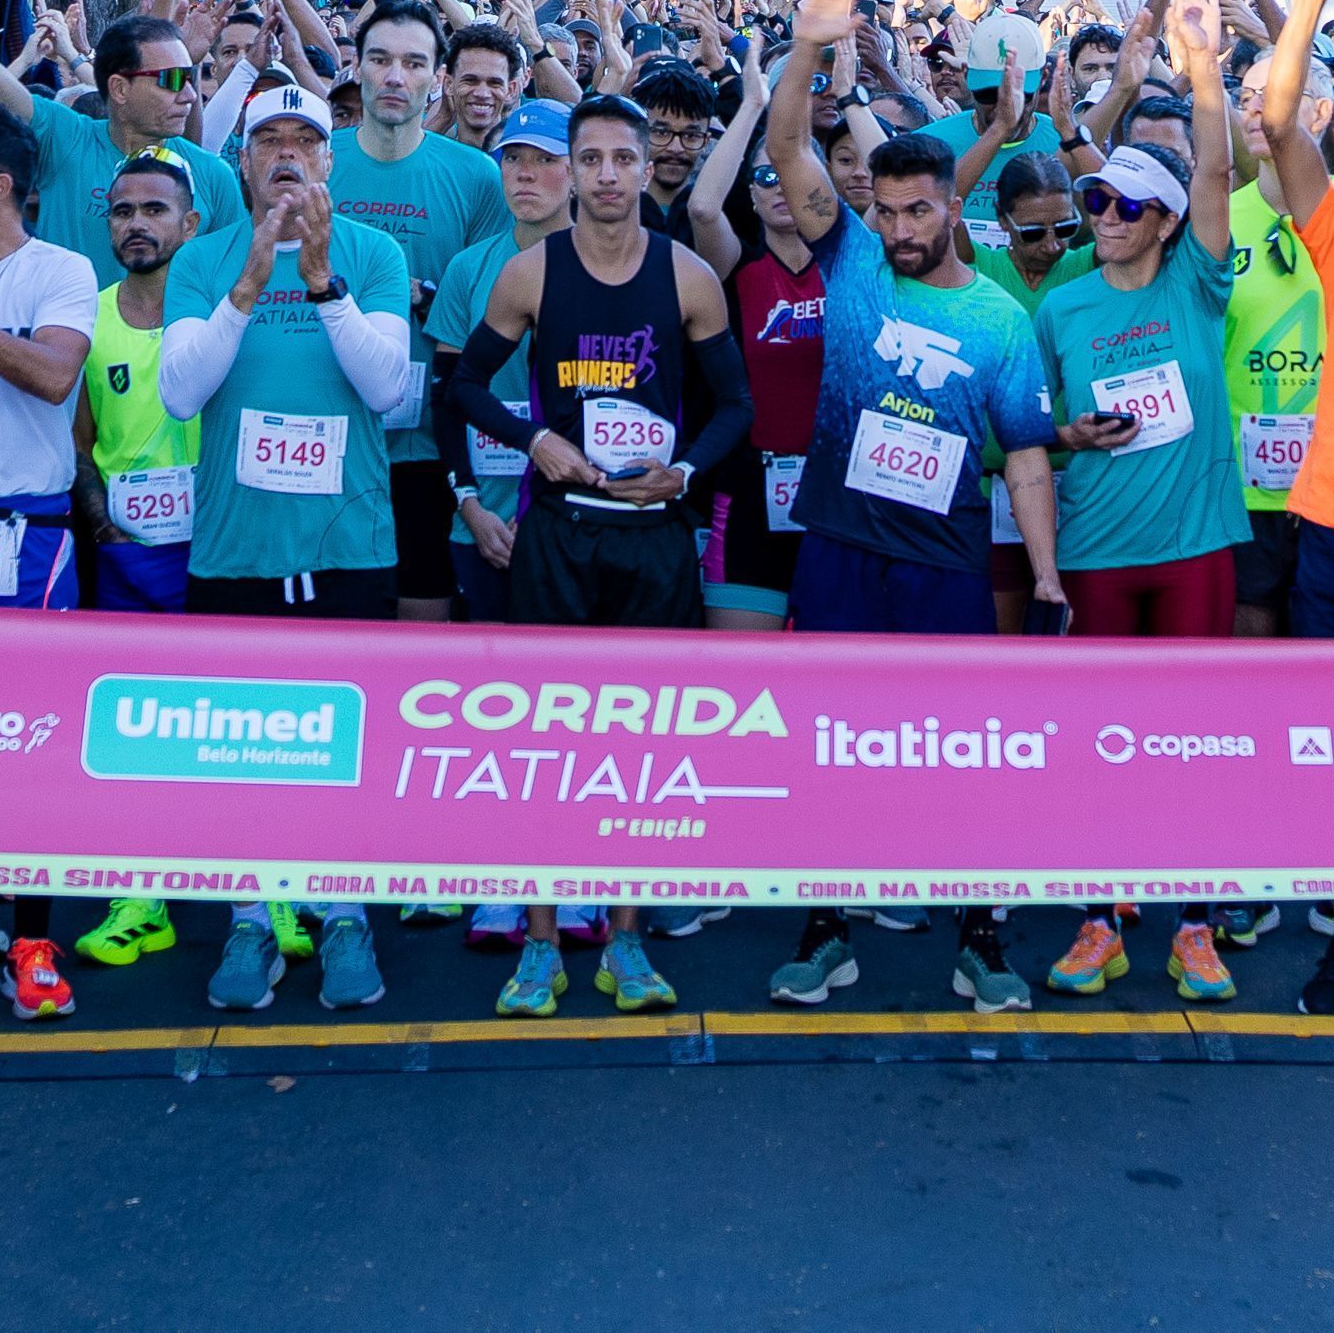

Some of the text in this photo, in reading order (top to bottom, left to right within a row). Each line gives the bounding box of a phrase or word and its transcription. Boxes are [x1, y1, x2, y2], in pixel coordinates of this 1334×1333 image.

[338, 201, 428, 220] CORRIDA
[578, 334, 636, 360] NEVES
[879, 391, 935, 423] Arjon
[593, 421, 665, 447] 5236
[255, 437, 326, 466] 5149
[868, 441, 940, 481] 4620
[1255, 439, 1310, 465] 450
[127, 490, 190, 522] 5291
[115, 696, 336, 744] Unimed
[398, 678, 790, 738] CORRIDA
[196, 744, 332, 767] Belo Horizonte
[1141, 734, 1257, 763] copasa
[394, 745, 708, 805] ITATIAIA
[628, 815, 707, 841] EDIÇÃO
[63, 868, 262, 892] SINTONIA
[306, 874, 750, 899] CORRA NA NOSSA SINTONIA
[797, 880, 1245, 899] CORRA NA NOSSA SINTONIA
